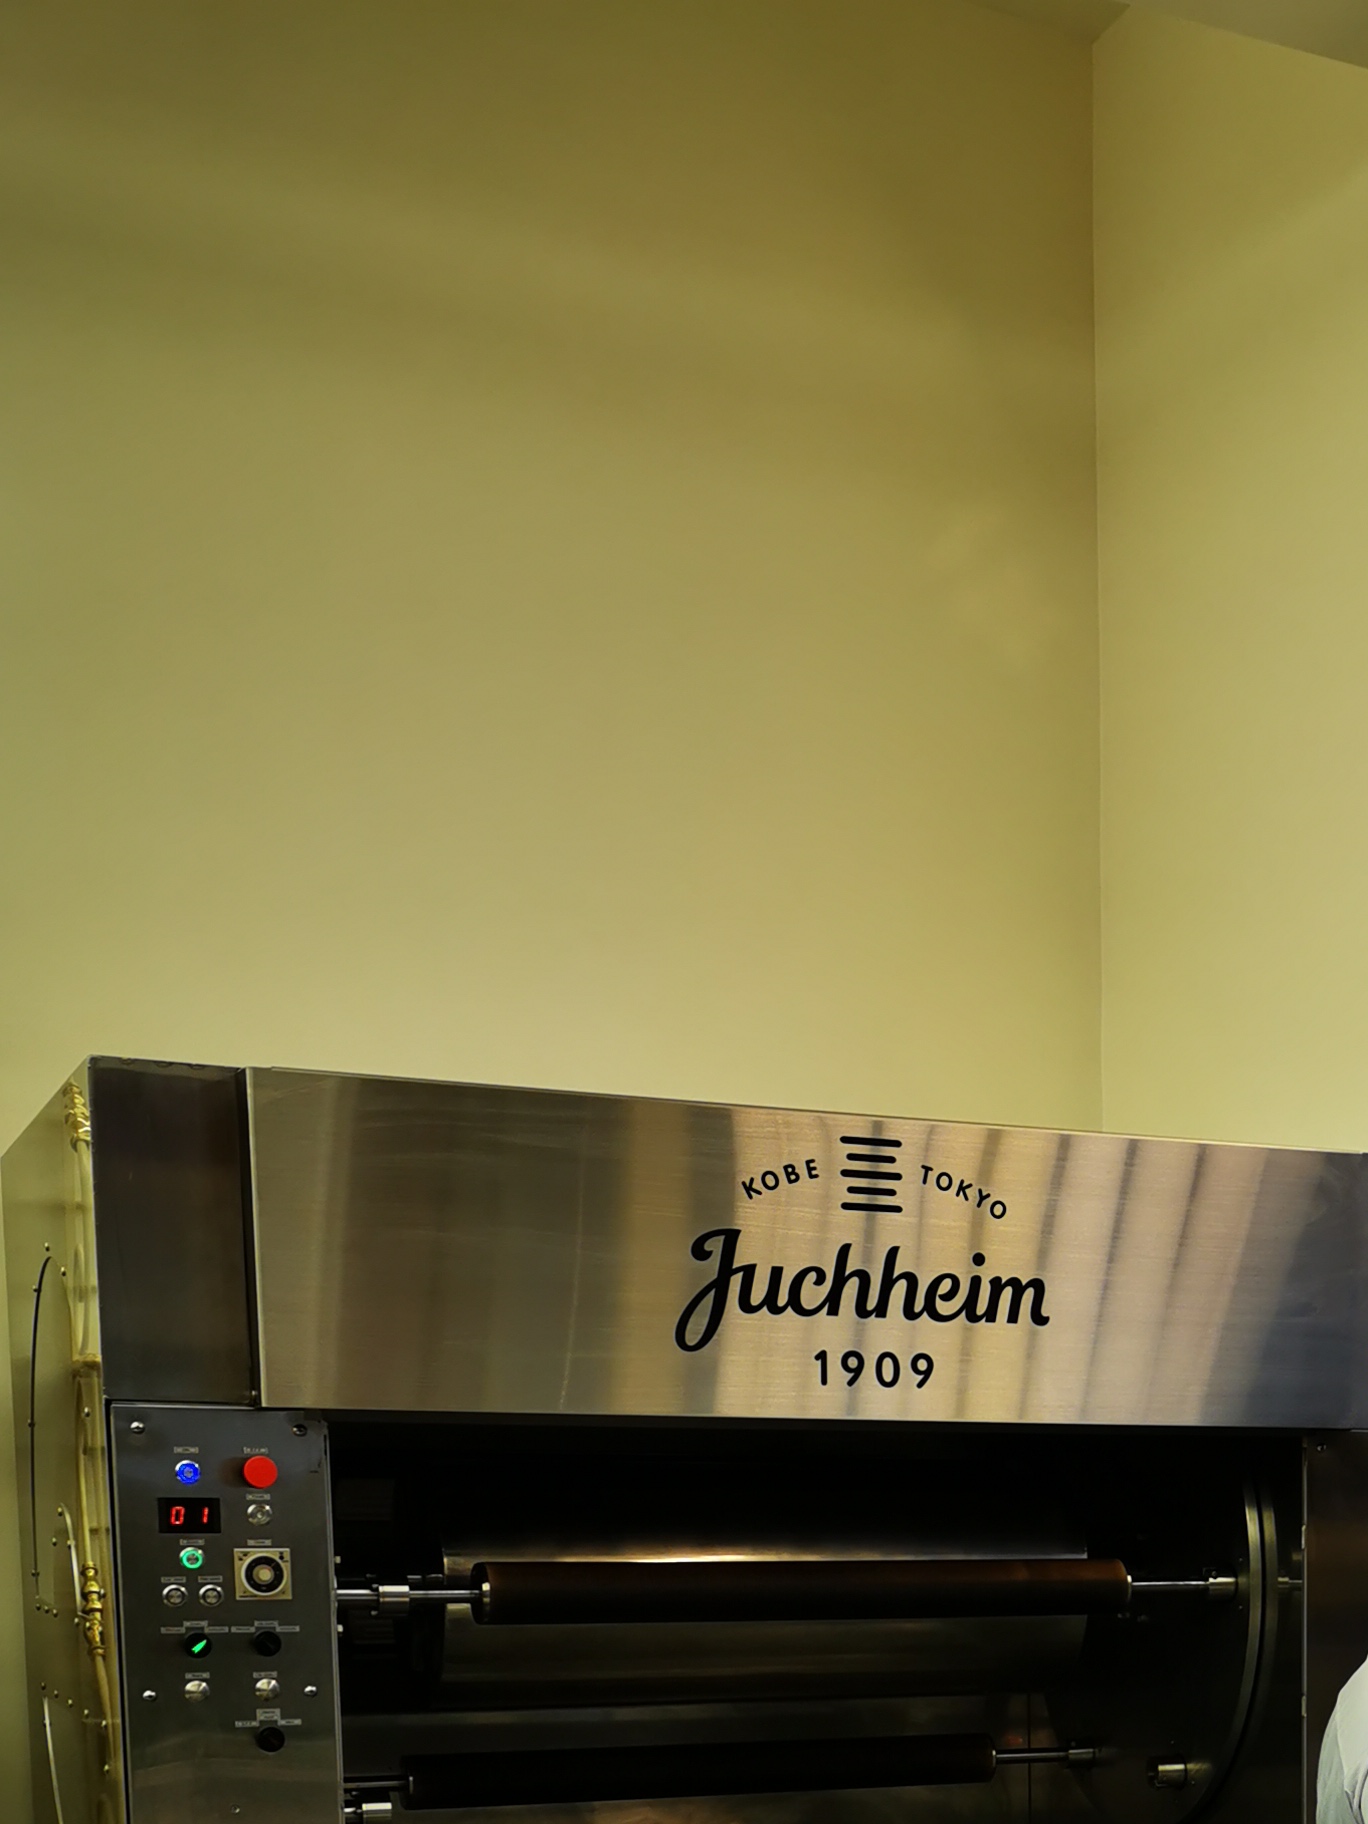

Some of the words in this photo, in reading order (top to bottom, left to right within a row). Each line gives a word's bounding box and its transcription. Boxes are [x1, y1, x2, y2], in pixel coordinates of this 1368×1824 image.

[740, 1158, 820, 1200] KOBE
[919, 1164, 1007, 1220] TOKYO
[673, 1228, 1051, 1352] Juchheim
[814, 1350, 935, 1389] 1909
